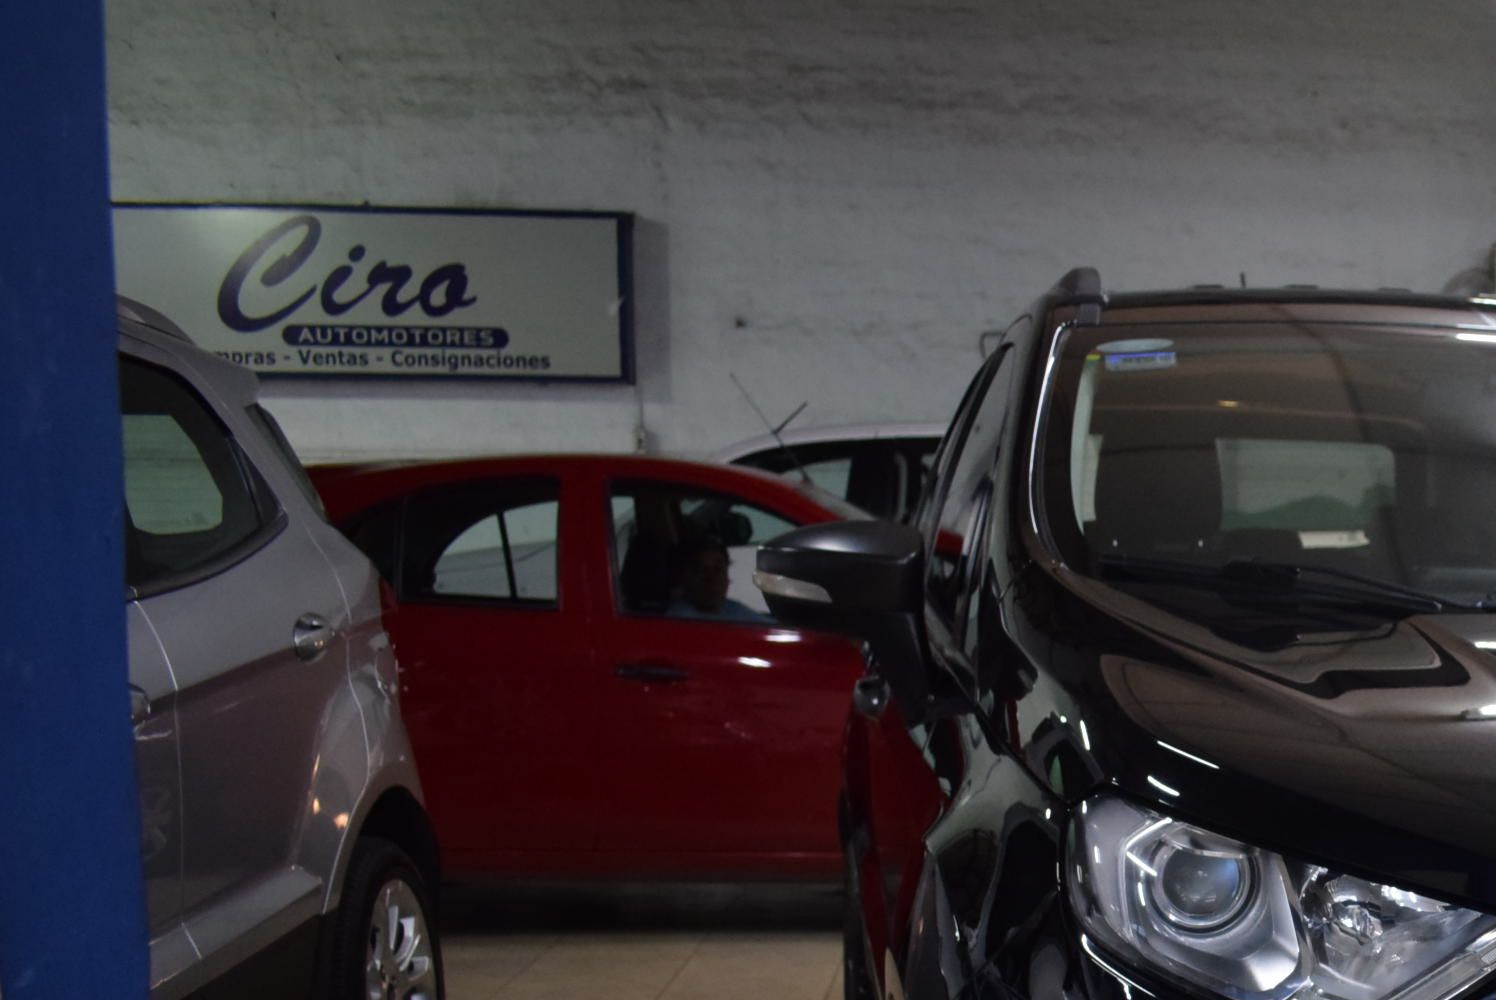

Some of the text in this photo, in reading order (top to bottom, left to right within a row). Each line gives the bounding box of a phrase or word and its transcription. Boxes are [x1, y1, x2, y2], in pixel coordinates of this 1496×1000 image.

[217, 215, 477, 333] Ciro
[298, 327, 494, 347] AUTOMOTORES
[217, 351, 276, 366] pras
[298, 350, 369, 366] Ventas
[391, 350, 551, 371] Consignaciones
